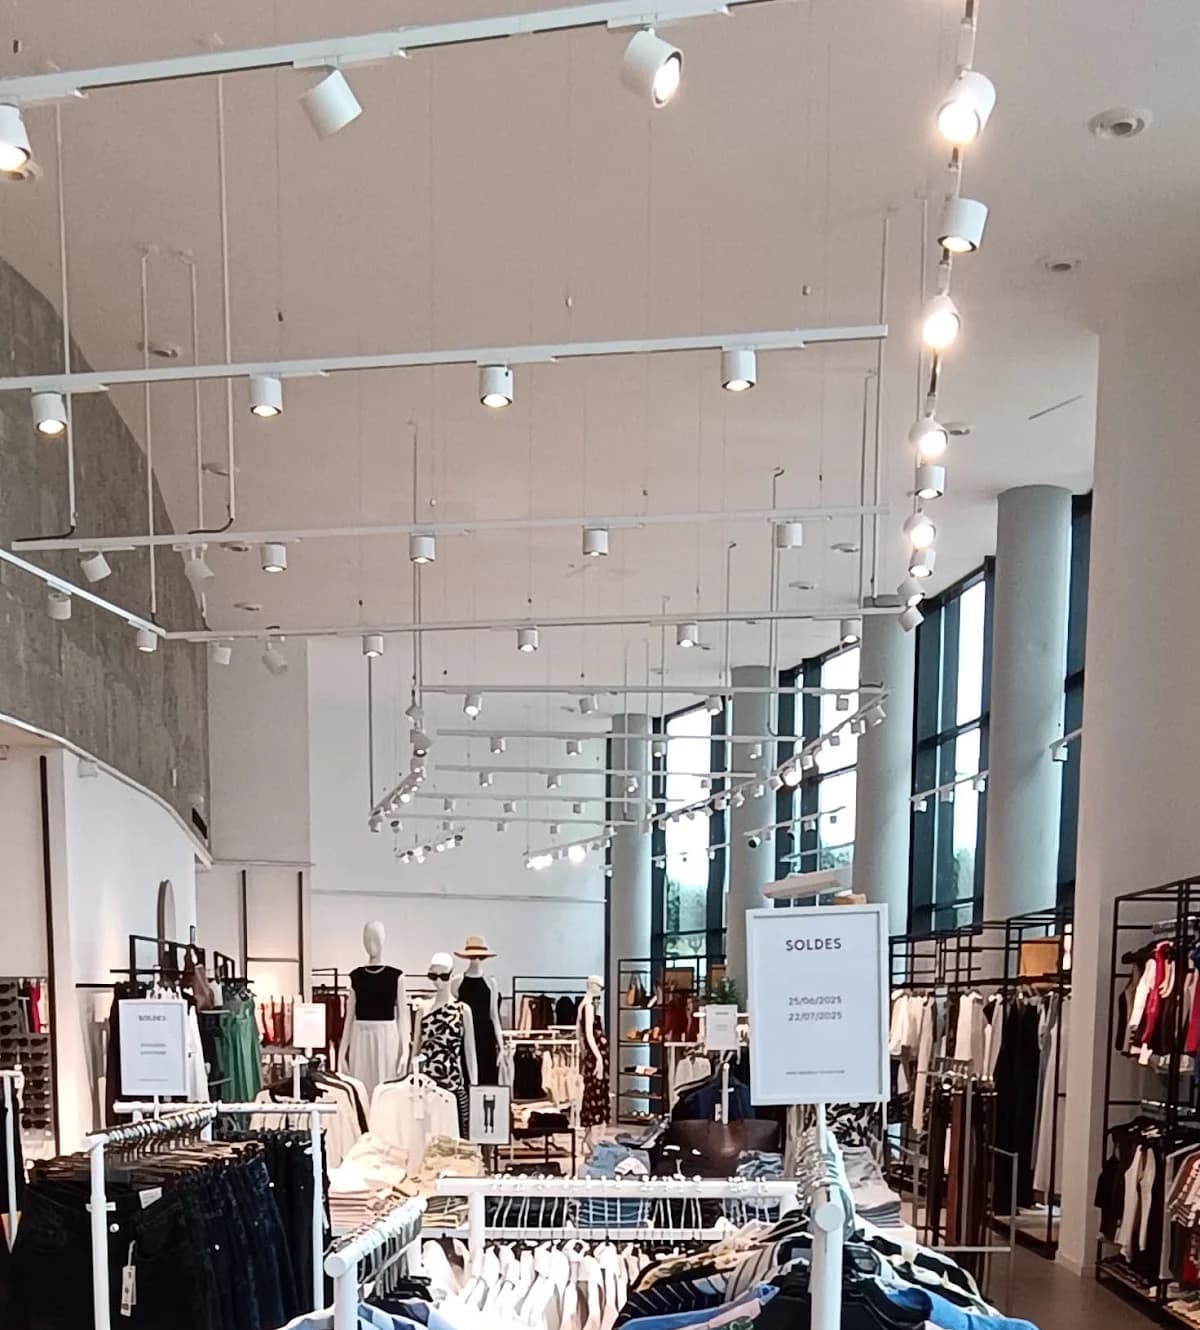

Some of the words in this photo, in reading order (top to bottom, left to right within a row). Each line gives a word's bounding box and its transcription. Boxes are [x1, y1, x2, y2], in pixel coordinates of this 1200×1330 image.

[785, 938, 842, 951] SOLDES
[788, 996, 842, 1006] 25/06/2025
[788, 1011, 842, 1021] 22/07/2025
